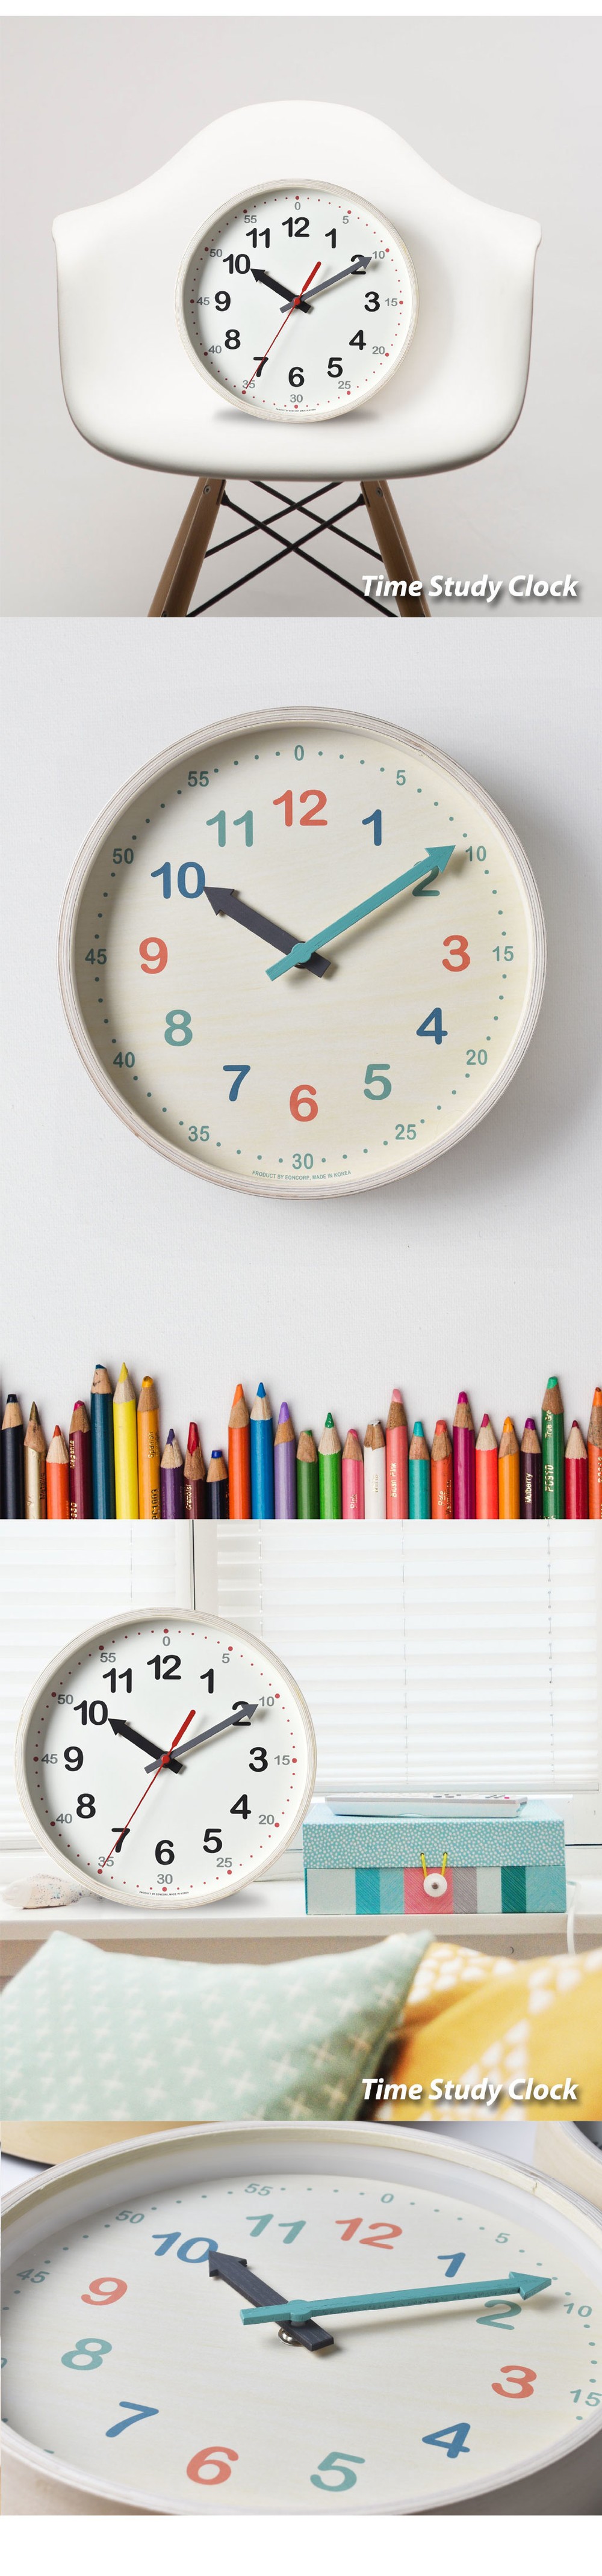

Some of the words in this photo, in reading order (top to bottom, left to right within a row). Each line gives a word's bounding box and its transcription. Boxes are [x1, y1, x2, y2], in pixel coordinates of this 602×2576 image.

[282, 217, 309, 237] 12
[246, 228, 270, 248] 11
[325, 229, 336, 248] 1
[223, 254, 250, 274] 10
[215, 291, 231, 311] 9
[364, 291, 380, 312] 3
[225, 329, 240, 350] 8
[349, 330, 366, 350] 4
[253, 357, 268, 377] 7
[289, 367, 304, 387] 6
[327, 357, 343, 378] 5
[242, 380, 255, 389] 35
[294, 745, 304, 760] 0
[188, 772, 209, 787] 55
[396, 770, 406, 786] 5
[273, 790, 327, 827] 12
[206, 810, 253, 847] 11
[362, 809, 382, 846] 1
[113, 848, 134, 864] 50
[467, 846, 487, 861] 10
[151, 861, 205, 899] 10
[85, 949, 107, 964] 45
[139, 937, 167, 974] 9
[442, 935, 470, 972] 3
[492, 946, 514, 961] 15
[164, 1009, 193, 1046] 8
[417, 1008, 448, 1044] 4
[113, 1052, 135, 1068] 40
[467, 1049, 487, 1065] 20
[223, 1065, 250, 1102] 7
[364, 1064, 391, 1100] 5
[290, 1085, 318, 1122] 6
[188, 1126, 209, 1142] 35
[396, 1124, 416, 1140] 25
[293, 1153, 313, 1169] 30
[252, 1170, 276, 1179] PRODUCT
[163, 1636, 170, 1646] 0
[100, 1653, 116, 1663] 55
[147, 1655, 181, 1680] 12
[222, 1654, 229, 1663] 5
[103, 1668, 132, 1693] 11
[200, 1669, 214, 1693] 1
[57, 1695, 73, 1704] 50
[259, 1696, 274, 1706] 10
[73, 1700, 108, 1725] 10
[42, 1754, 58, 1764] 45
[64, 1746, 83, 1771] 9
[249, 1747, 268, 1772] 3
[275, 1755, 290, 1765] 15
[76, 1793, 96, 1819] 8
[230, 1795, 251, 1819] 4
[56, 1814, 72, 1823] 40
[259, 1815, 274, 1825] 20
[111, 1828, 130, 1853] 7
[203, 1829, 222, 1853] 5
[98, 1857, 114, 1867] 35
[155, 1840, 175, 1865] 6
[217, 1858, 232, 1867] 25
[157, 1874, 173, 1884] 30
[244, 2183, 272, 2195] 55
[381, 2194, 394, 2203] 0
[115, 2210, 145, 2225] 50
[246, 2214, 306, 2244] 11
[335, 2218, 402, 2249] 12
[495, 2233, 510, 2243] 5
[151, 2231, 218, 2264] 10
[438, 2252, 465, 2278] 1
[16, 2268, 50, 2284] 45
[81, 2278, 128, 2305] 9
[476, 2299, 522, 2330] 2
[563, 2303, 592, 2317] 10
[61, 2338, 112, 2370] 8
[491, 2365, 536, 2399] 3
[570, 2390, 602, 2406] 15
[106, 2402, 159, 2438] 7
[422, 2423, 470, 2458] 4
[187, 2447, 238, 2485] 6
[310, 2451, 365, 2492] 5
